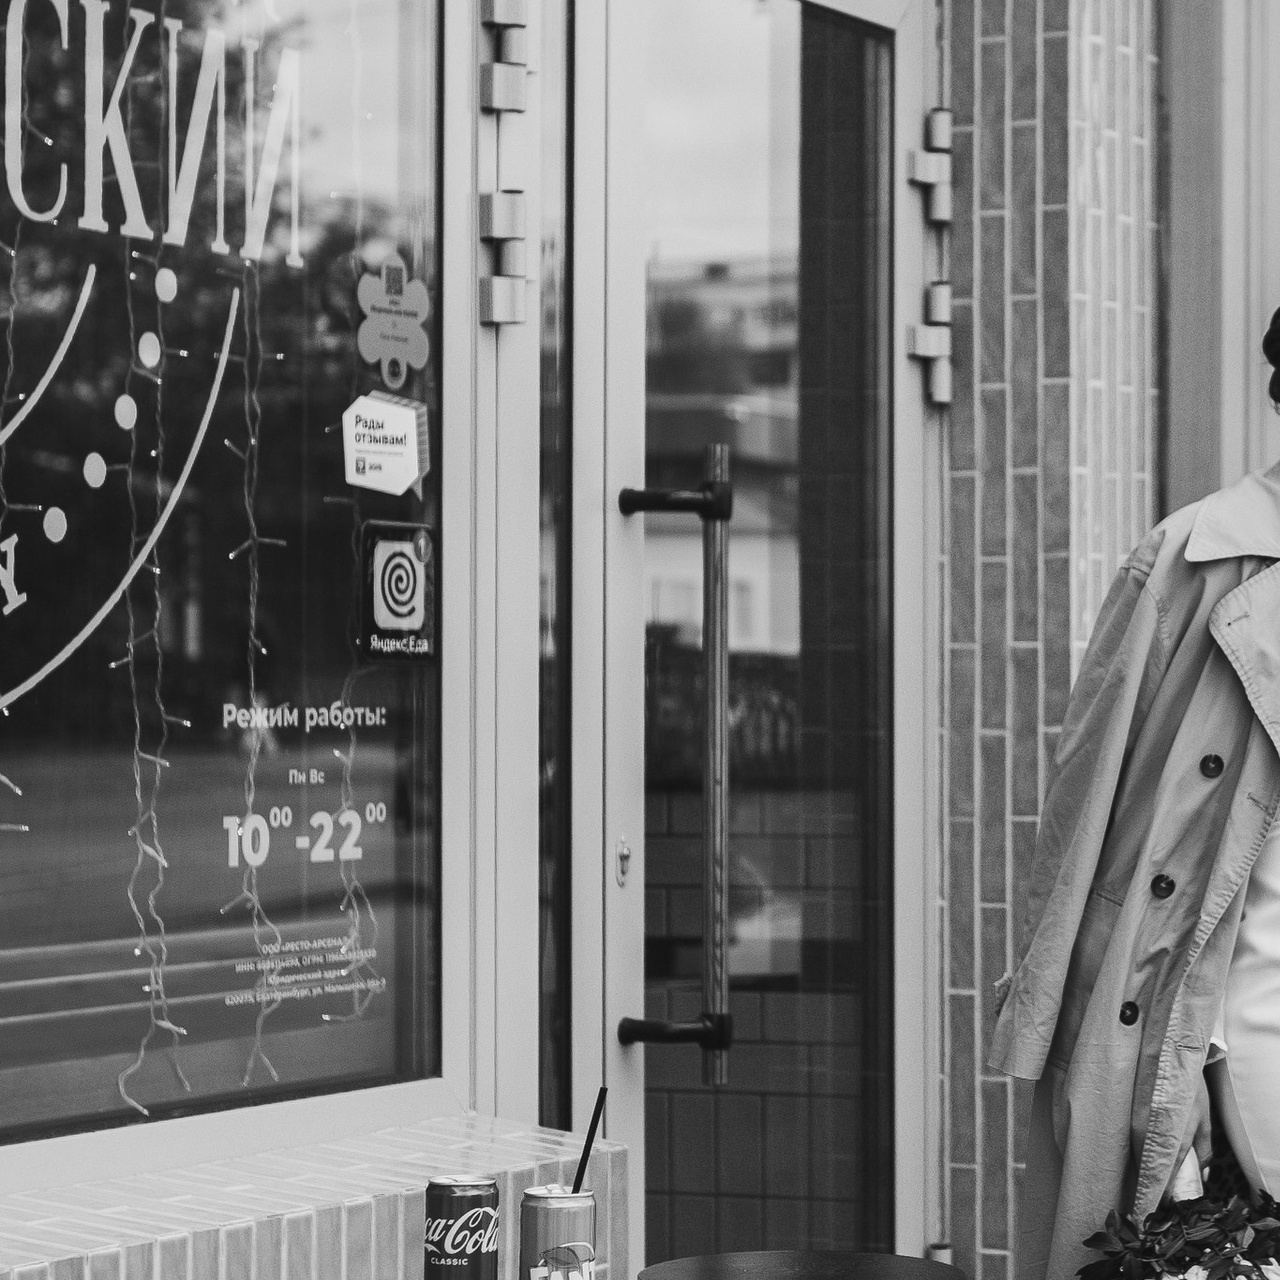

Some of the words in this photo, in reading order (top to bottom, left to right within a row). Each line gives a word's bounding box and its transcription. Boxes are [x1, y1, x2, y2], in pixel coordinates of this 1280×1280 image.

[355, 414, 384, 430] Рады
[354, 432, 407, 447] отзывам!
[223, 703, 299, 729] Режим
[305, 700, 387, 733] работы:
[430, 1257, 469, 1266] CLASSIC
